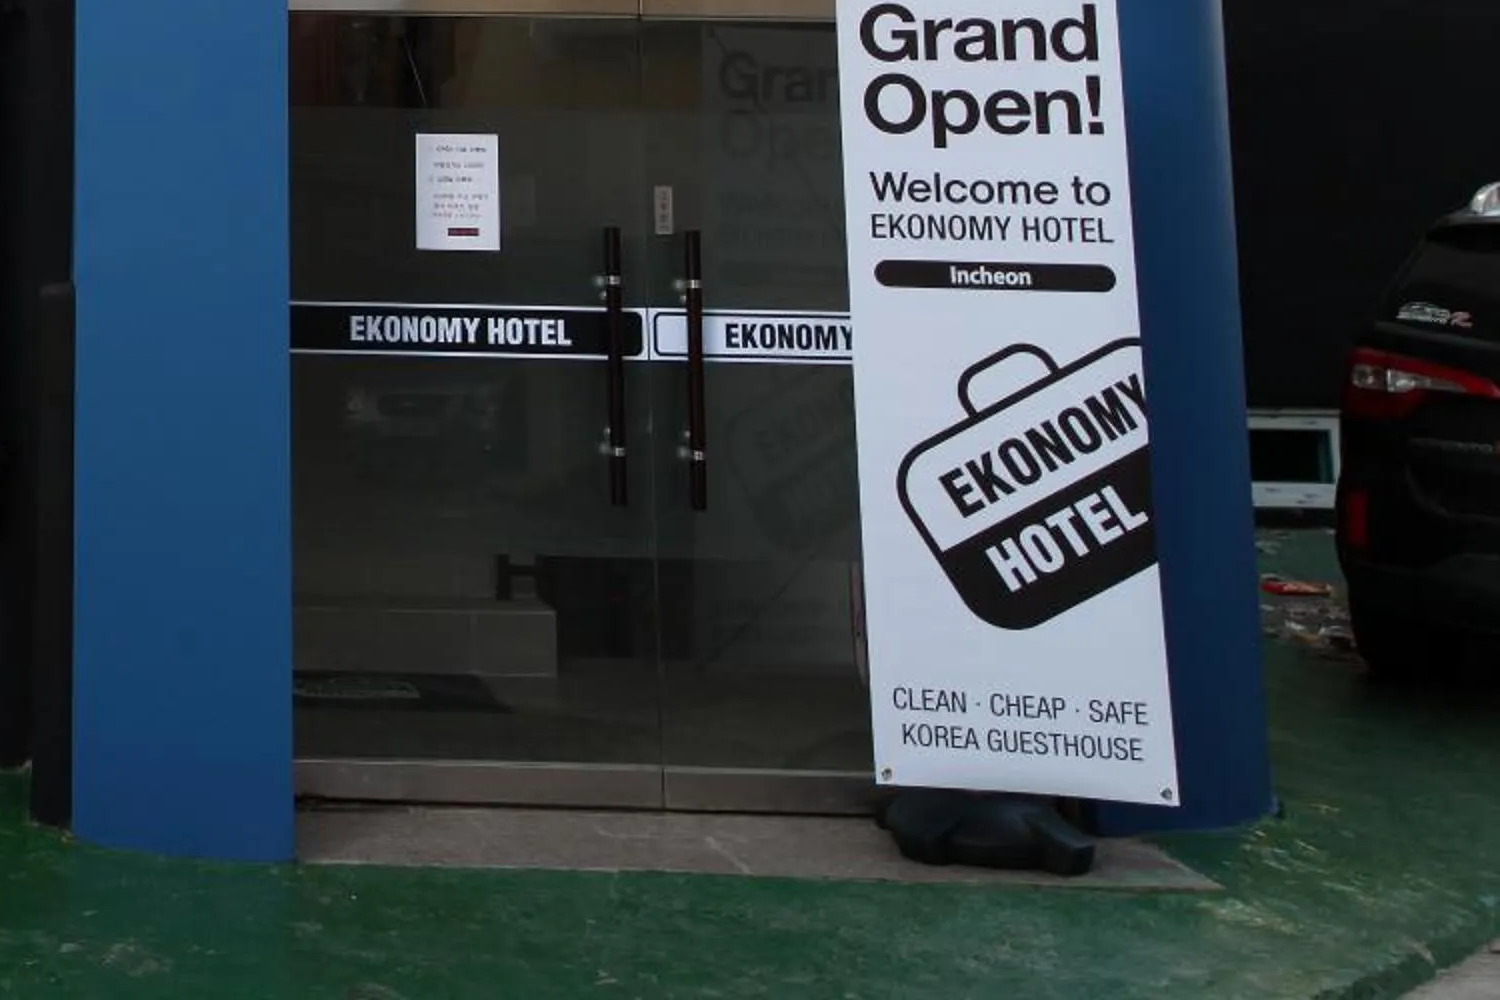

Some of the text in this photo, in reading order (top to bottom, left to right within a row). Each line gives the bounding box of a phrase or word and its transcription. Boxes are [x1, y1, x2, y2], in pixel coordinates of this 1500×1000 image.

[859, 2, 1100, 63] Grand
[863, 72, 1105, 149] Open!
[869, 171, 1111, 206] Welcome to
[870, 213, 1114, 244] EKONOMY HOTEL
[950, 265, 1032, 287] Incheon
[349, 314, 572, 347] EKONOMY HOTEL
[725, 323, 853, 351] EKONOMY
[938, 373, 1150, 519] EKONOMY
[985, 483, 1150, 594] HOTEL
[892, 686, 1150, 726] CLEAN CHEAP SAFE
[901, 723, 1145, 762] KOREA GUESTHOUSE
